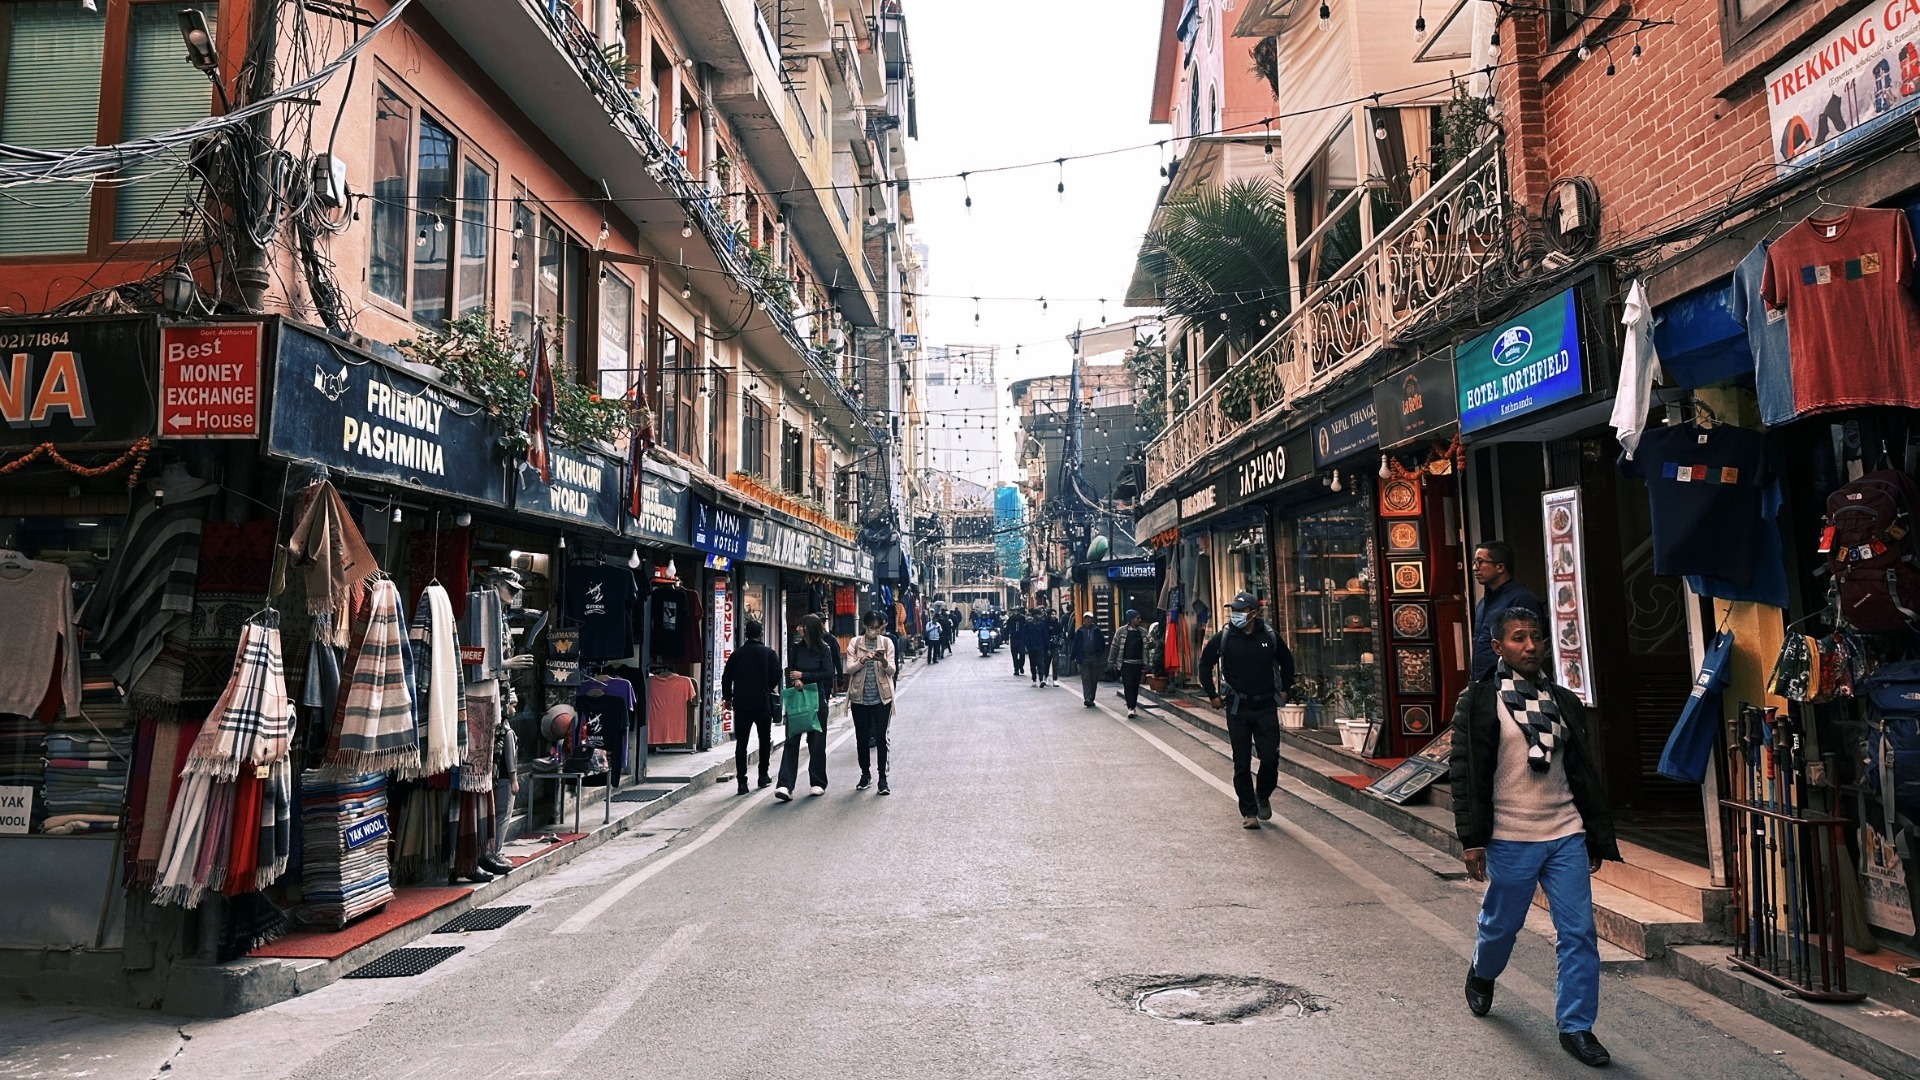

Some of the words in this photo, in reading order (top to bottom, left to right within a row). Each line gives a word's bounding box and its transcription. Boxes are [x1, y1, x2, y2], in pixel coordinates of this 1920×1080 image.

[1886, 40, 1893, 50] &
[1769, 17, 1876, 106] TREKKING
[168, 337, 222, 362] Best
[179, 363, 244, 383] MONEY
[1466, 380, 1500, 410] HOTEL
[1501, 349, 1570, 397] NORTHFIELD
[166, 386, 254, 406] EXCHANGE
[366, 378, 444, 437] FRIENDLY
[1500, 396, 1534, 416] Kathmandu
[195, 410, 254, 429] House
[1330, 416, 1350, 435] NEPAL
[342, 415, 446, 477] PASHMINA
[556, 454, 602, 493] KHUKURI
[550, 485, 589, 517] WORLD
[714, 510, 740, 539] NANA
[713, 534, 740, 554] HOTELS
[1121, 565, 1156, 575] Ultimate
[722, 593, 733, 643] MONEY
[705, 649, 714, 741] EXCHANGE
[0, 796, 25, 808] YAK
[348, 827, 364, 843] YAK
[362, 819, 385, 837] WOOL
